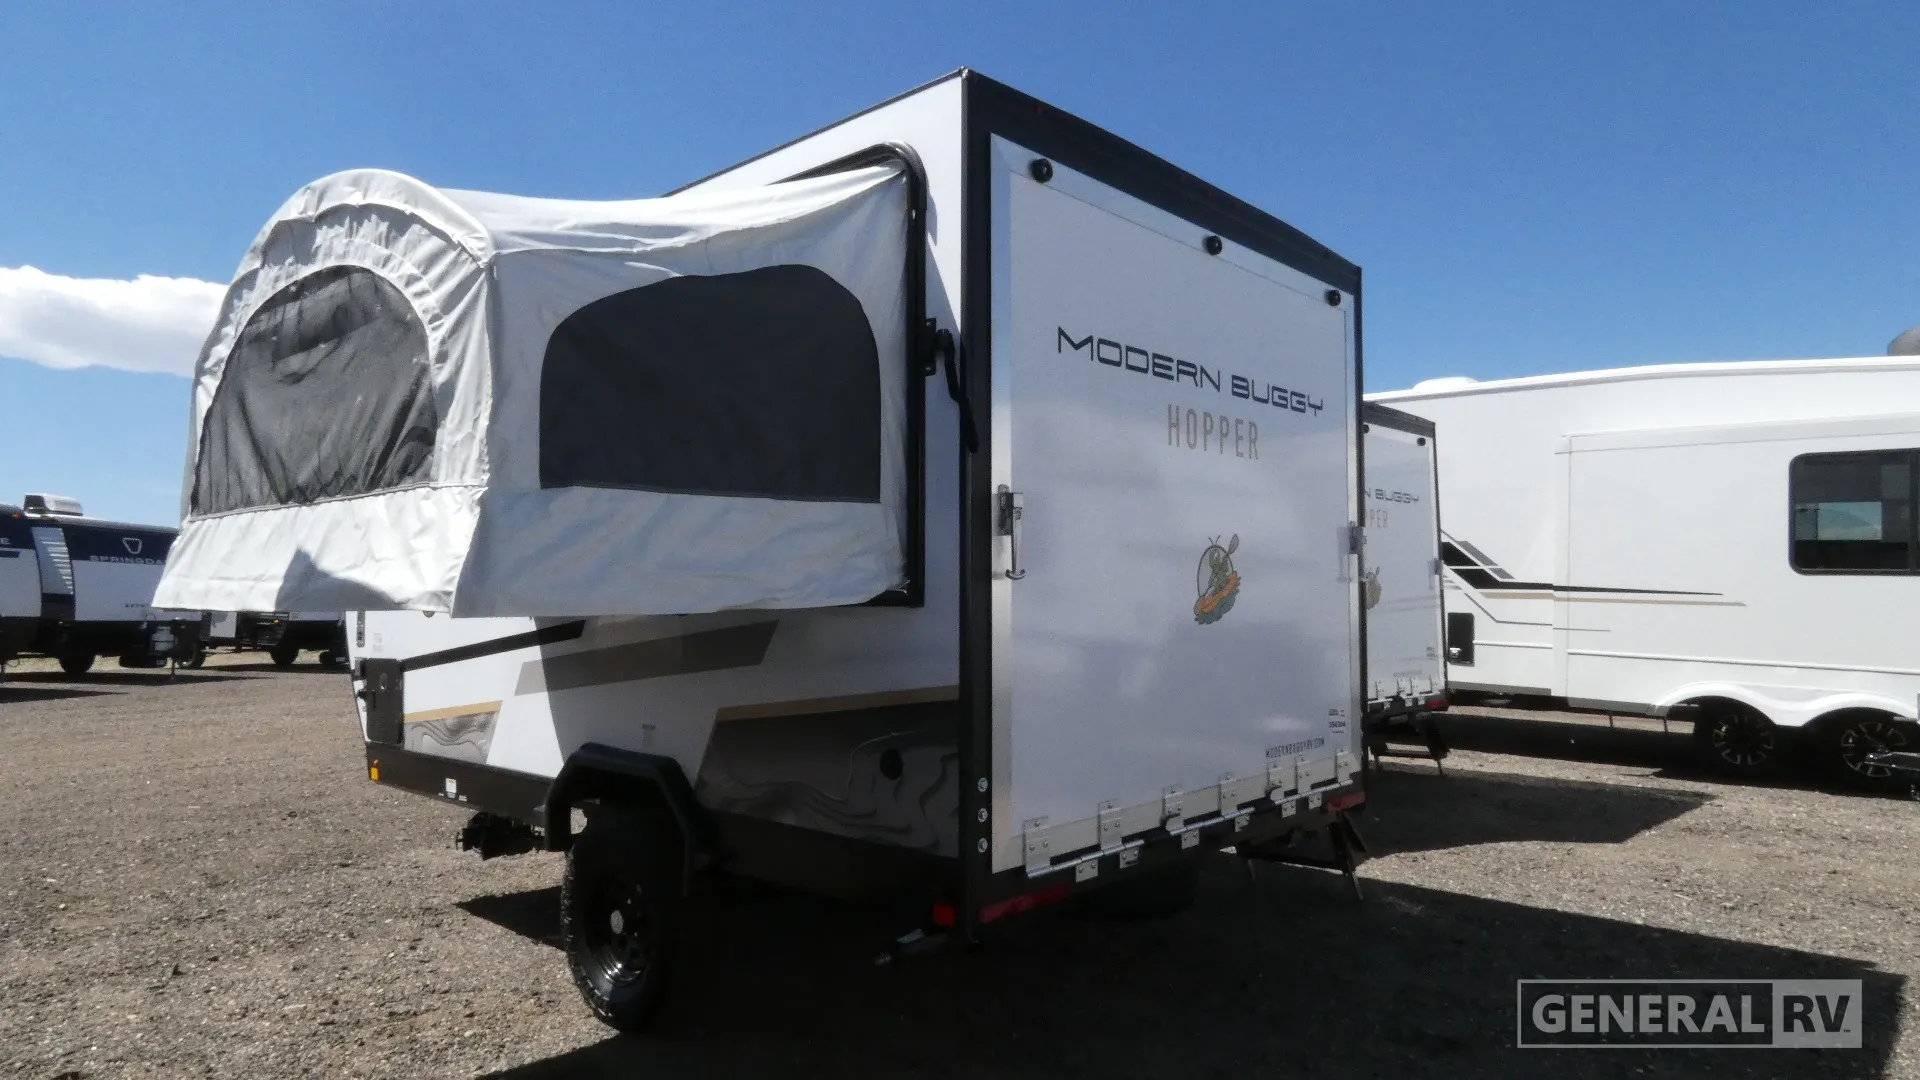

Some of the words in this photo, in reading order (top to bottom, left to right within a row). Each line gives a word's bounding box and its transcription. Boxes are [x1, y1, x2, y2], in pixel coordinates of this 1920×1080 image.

[1058, 326, 1220, 392] MODERN
[1231, 374, 1323, 417] BUGGY
[1167, 403, 1259, 460] HOPPER
[1375, 488, 1420, 505] BUGGY
